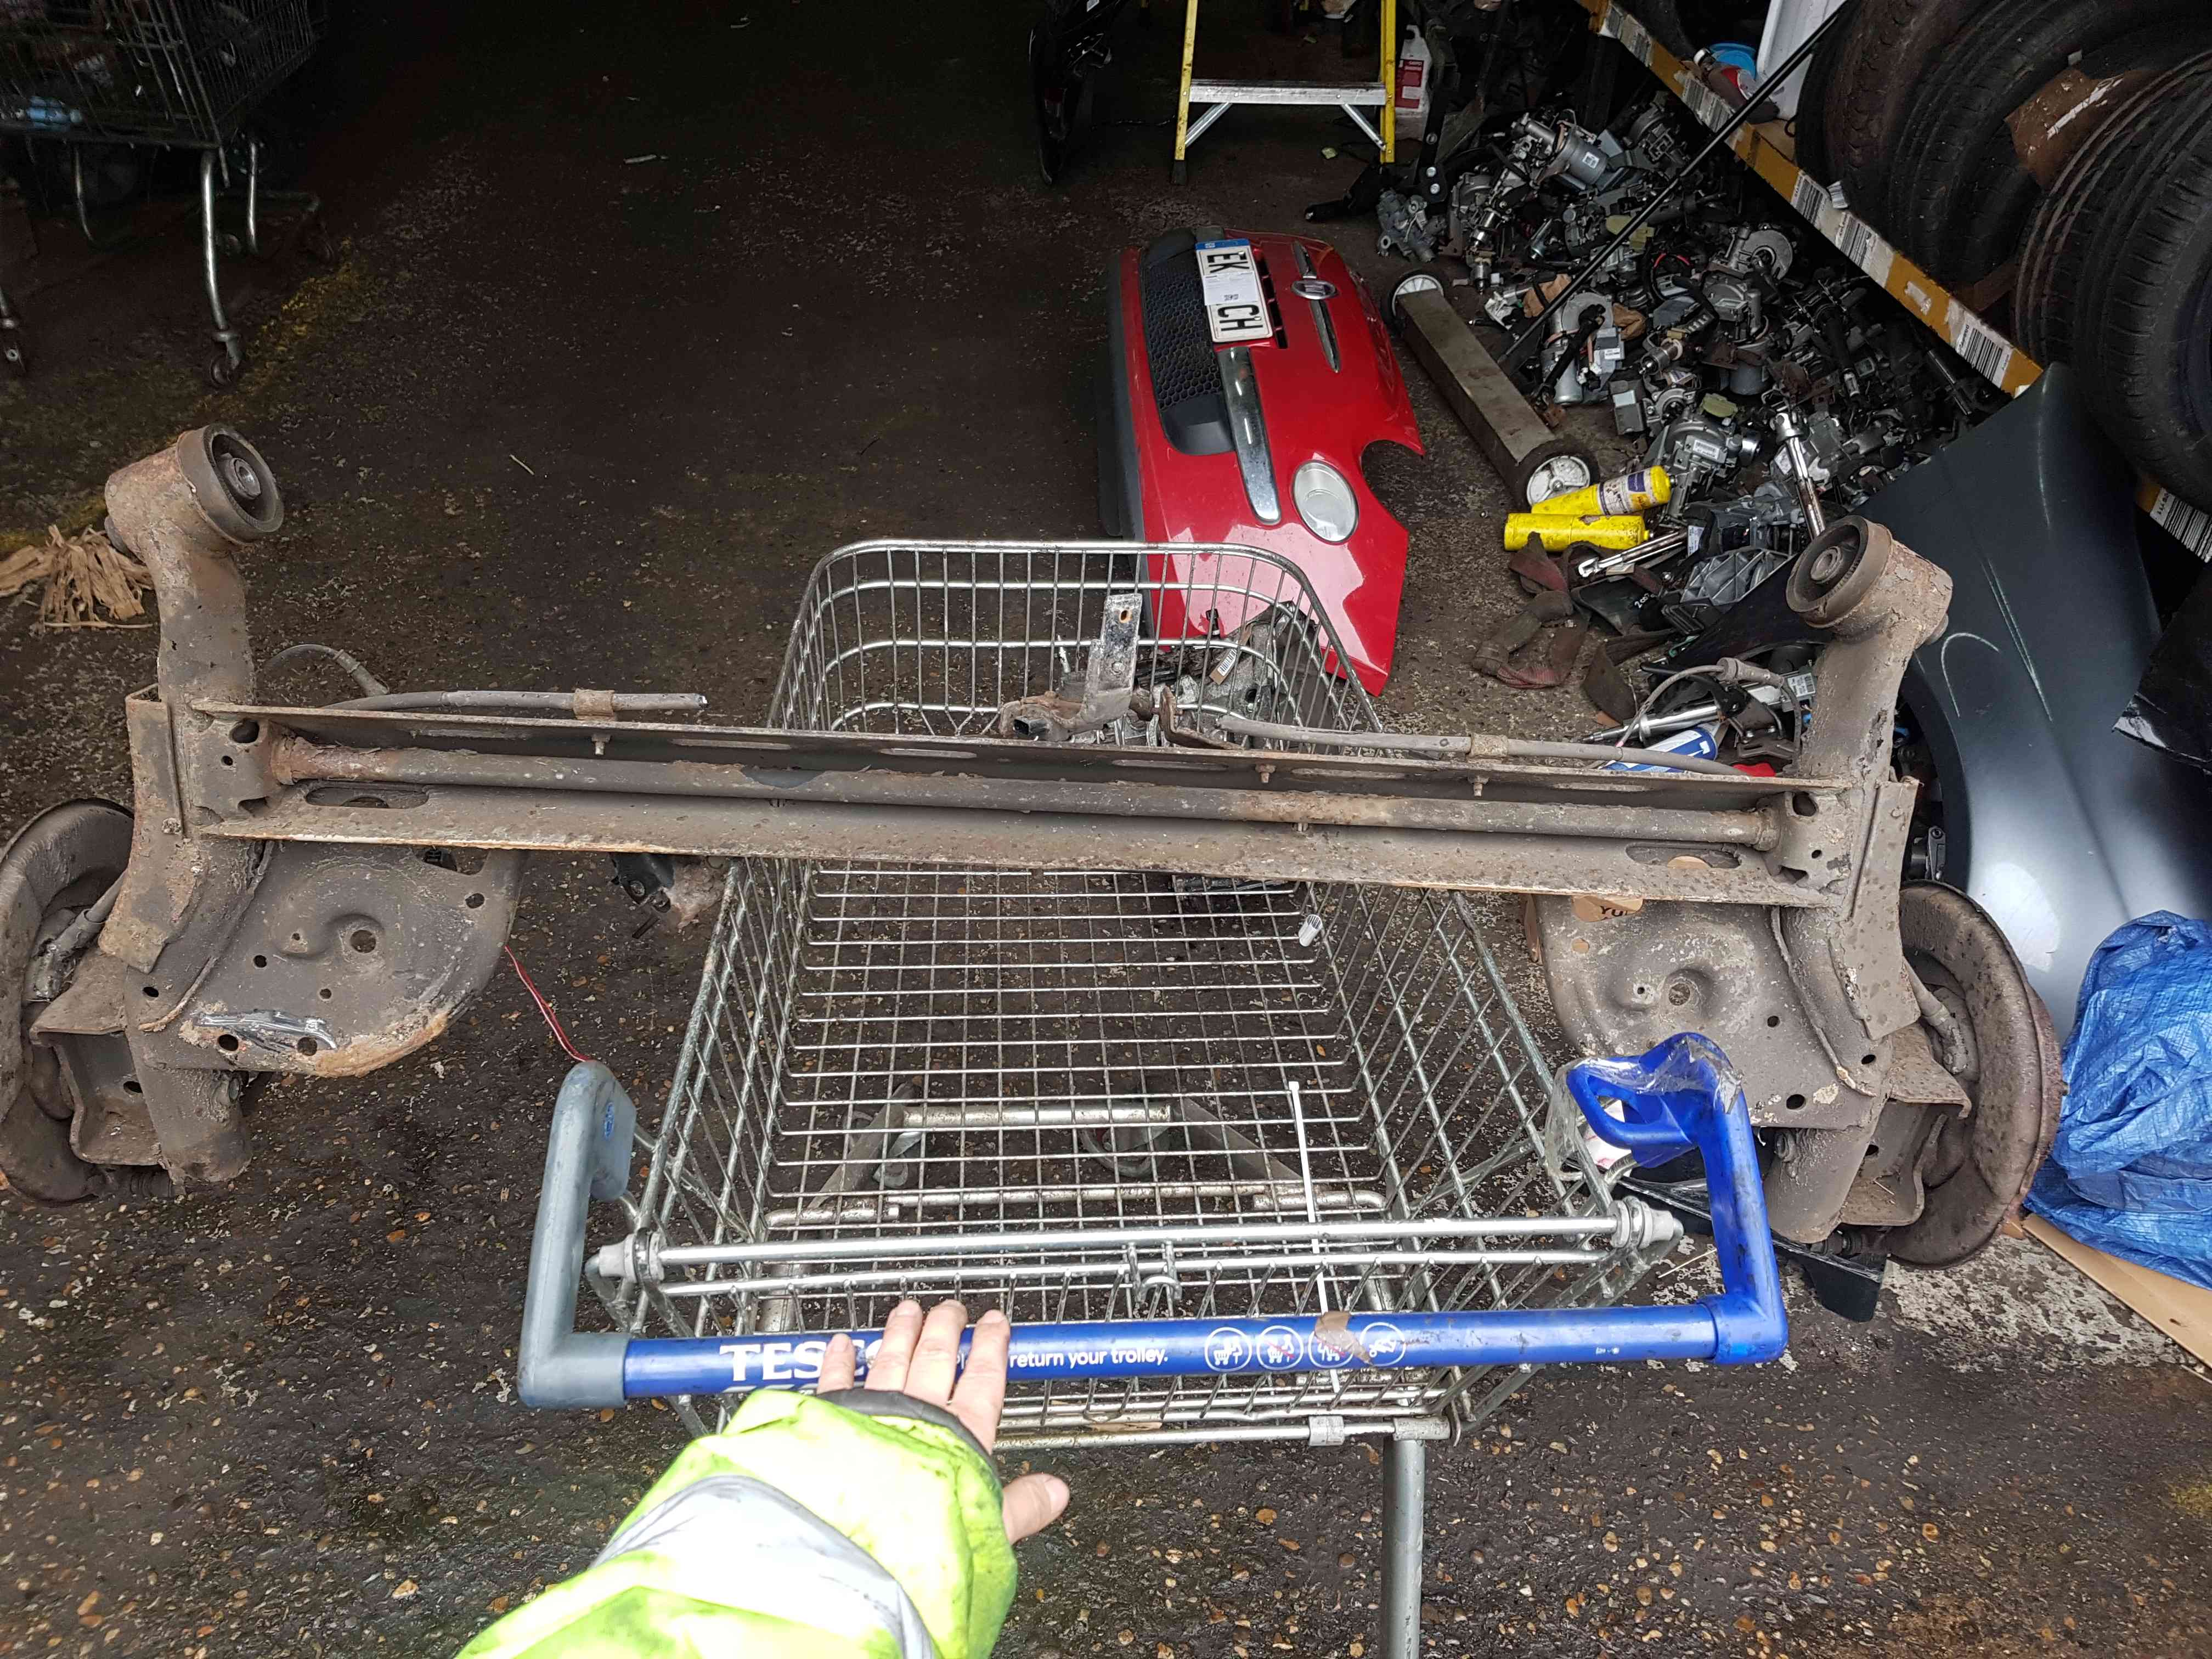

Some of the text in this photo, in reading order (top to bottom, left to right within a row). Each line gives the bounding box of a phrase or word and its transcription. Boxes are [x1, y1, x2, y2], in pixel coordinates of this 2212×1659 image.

[1207, 252, 1250, 273] EK
[1216, 304, 1263, 331] CH
[719, 1339, 883, 1381] TES
[1009, 1346, 1169, 1369] return your trolley.
